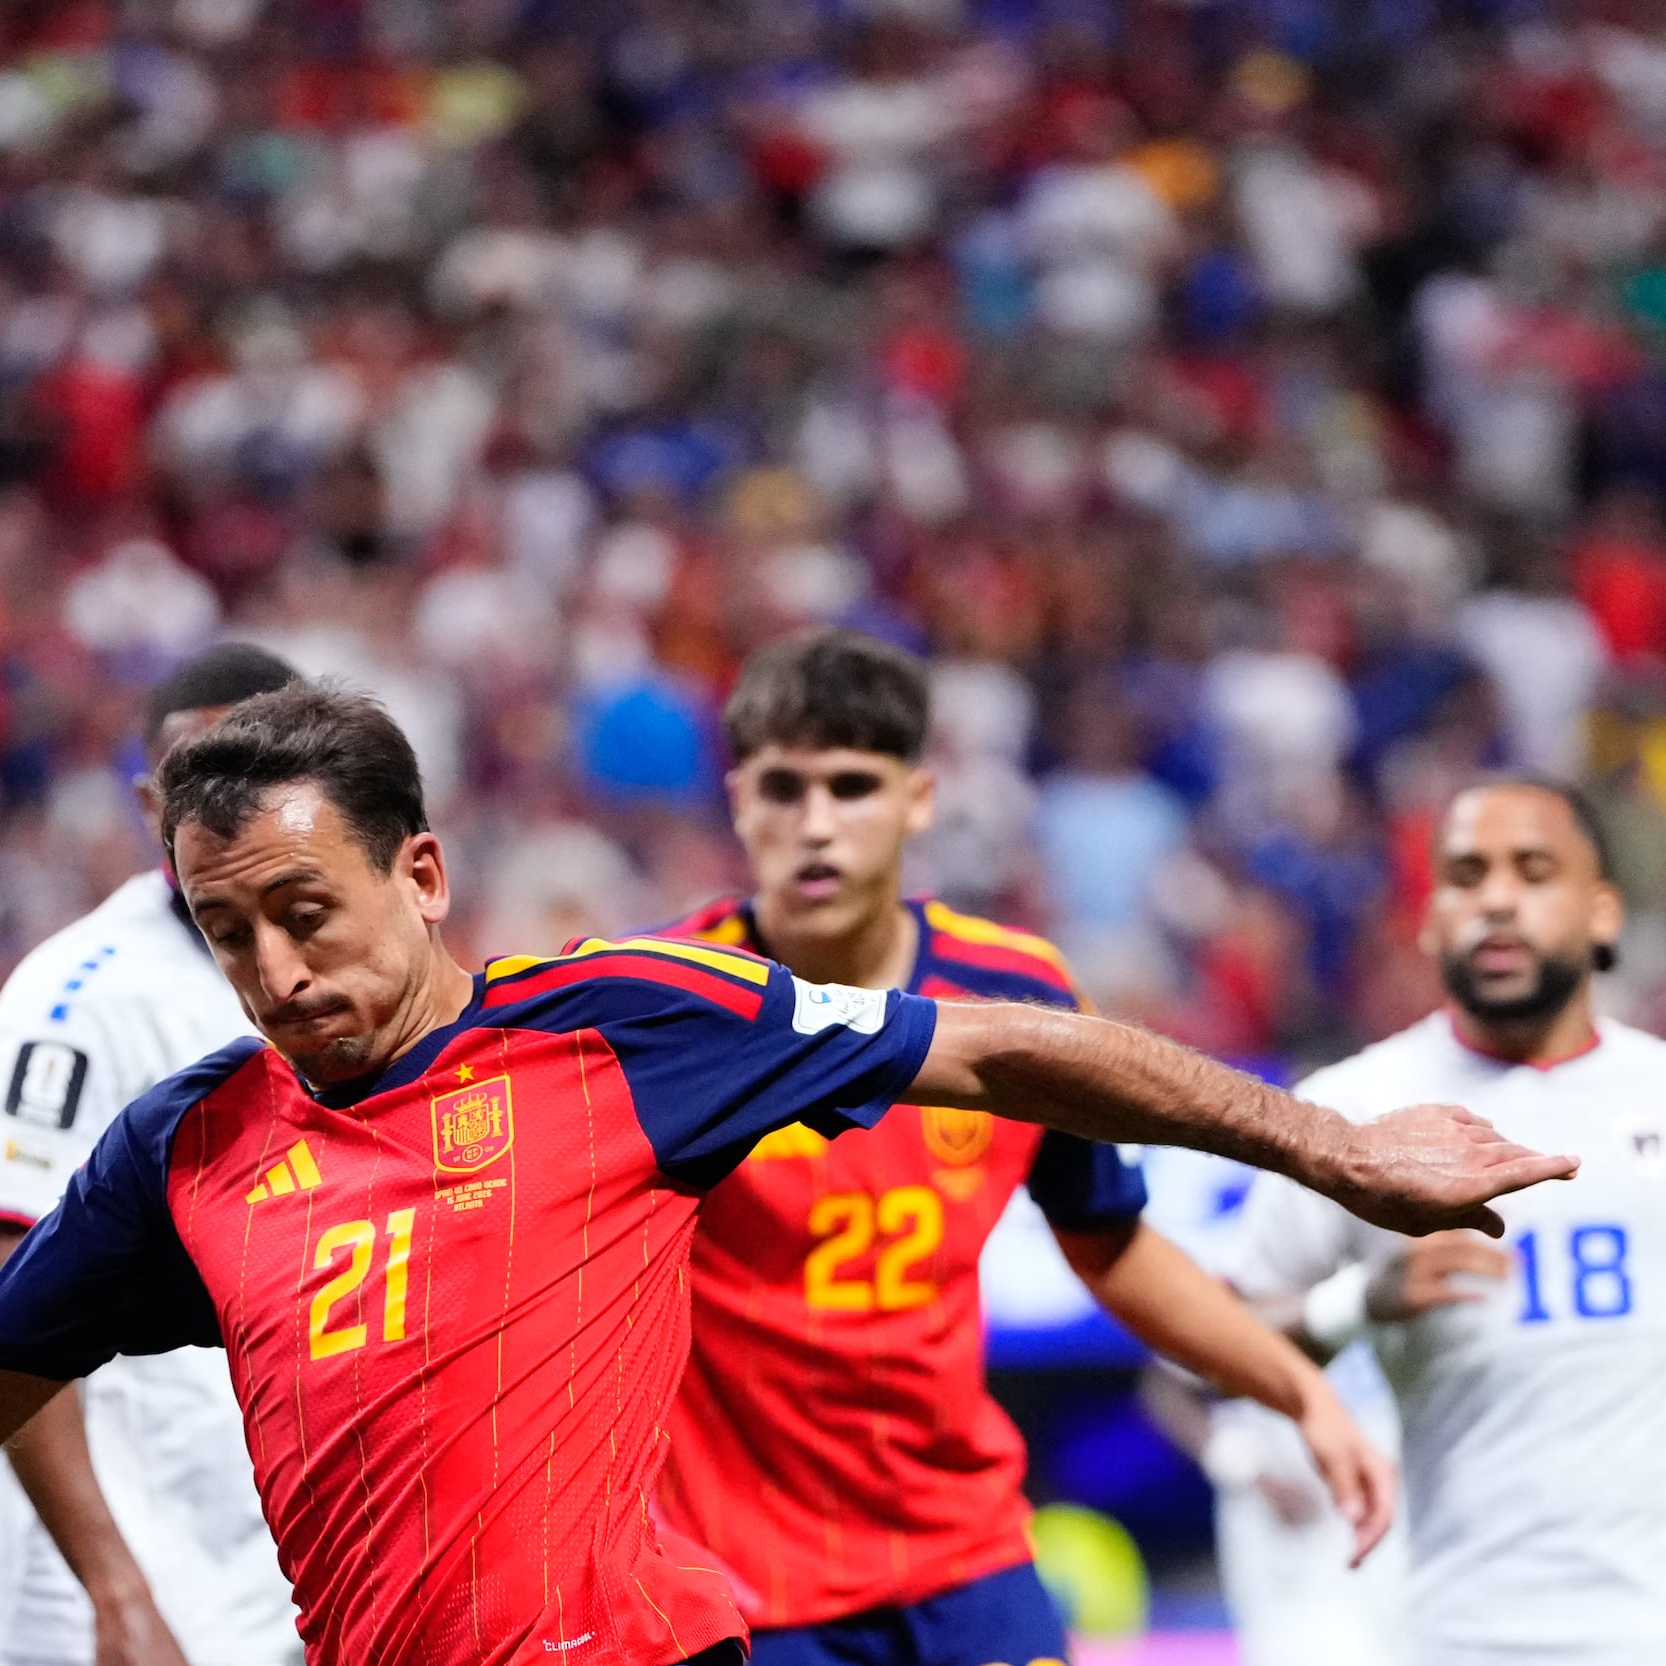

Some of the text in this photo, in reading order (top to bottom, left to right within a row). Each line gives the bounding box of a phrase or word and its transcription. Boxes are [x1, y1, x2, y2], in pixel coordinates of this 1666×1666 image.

[309, 1207, 416, 1361] 21
[804, 1184, 945, 1312] 22
[1516, 1225, 1632, 1323] 18
